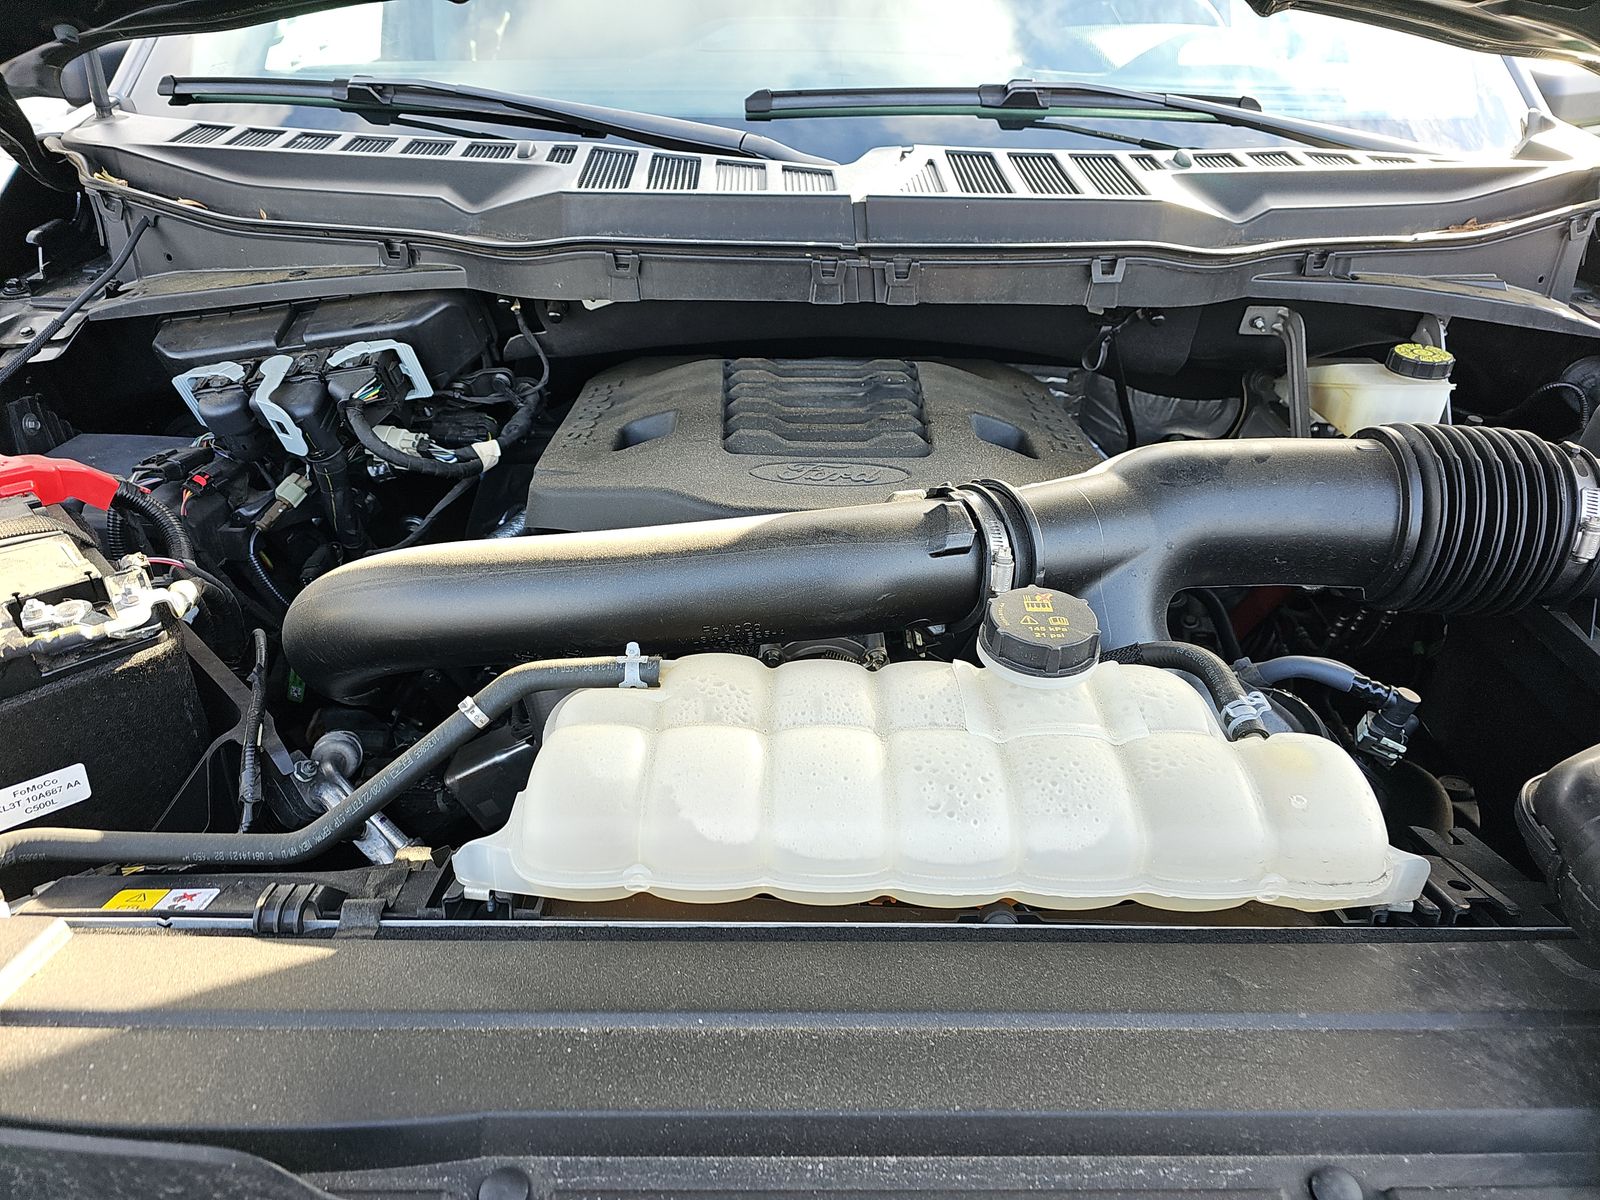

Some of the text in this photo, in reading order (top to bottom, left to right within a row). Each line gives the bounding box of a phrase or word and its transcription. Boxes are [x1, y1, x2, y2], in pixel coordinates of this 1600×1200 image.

[777, 463, 881, 483] Ford
[12, 778, 59, 798] FoMoCo
[25, 785, 63, 804] 10A687
[66, 779, 81, 790] AA
[24, 798, 58, 814] C500L
